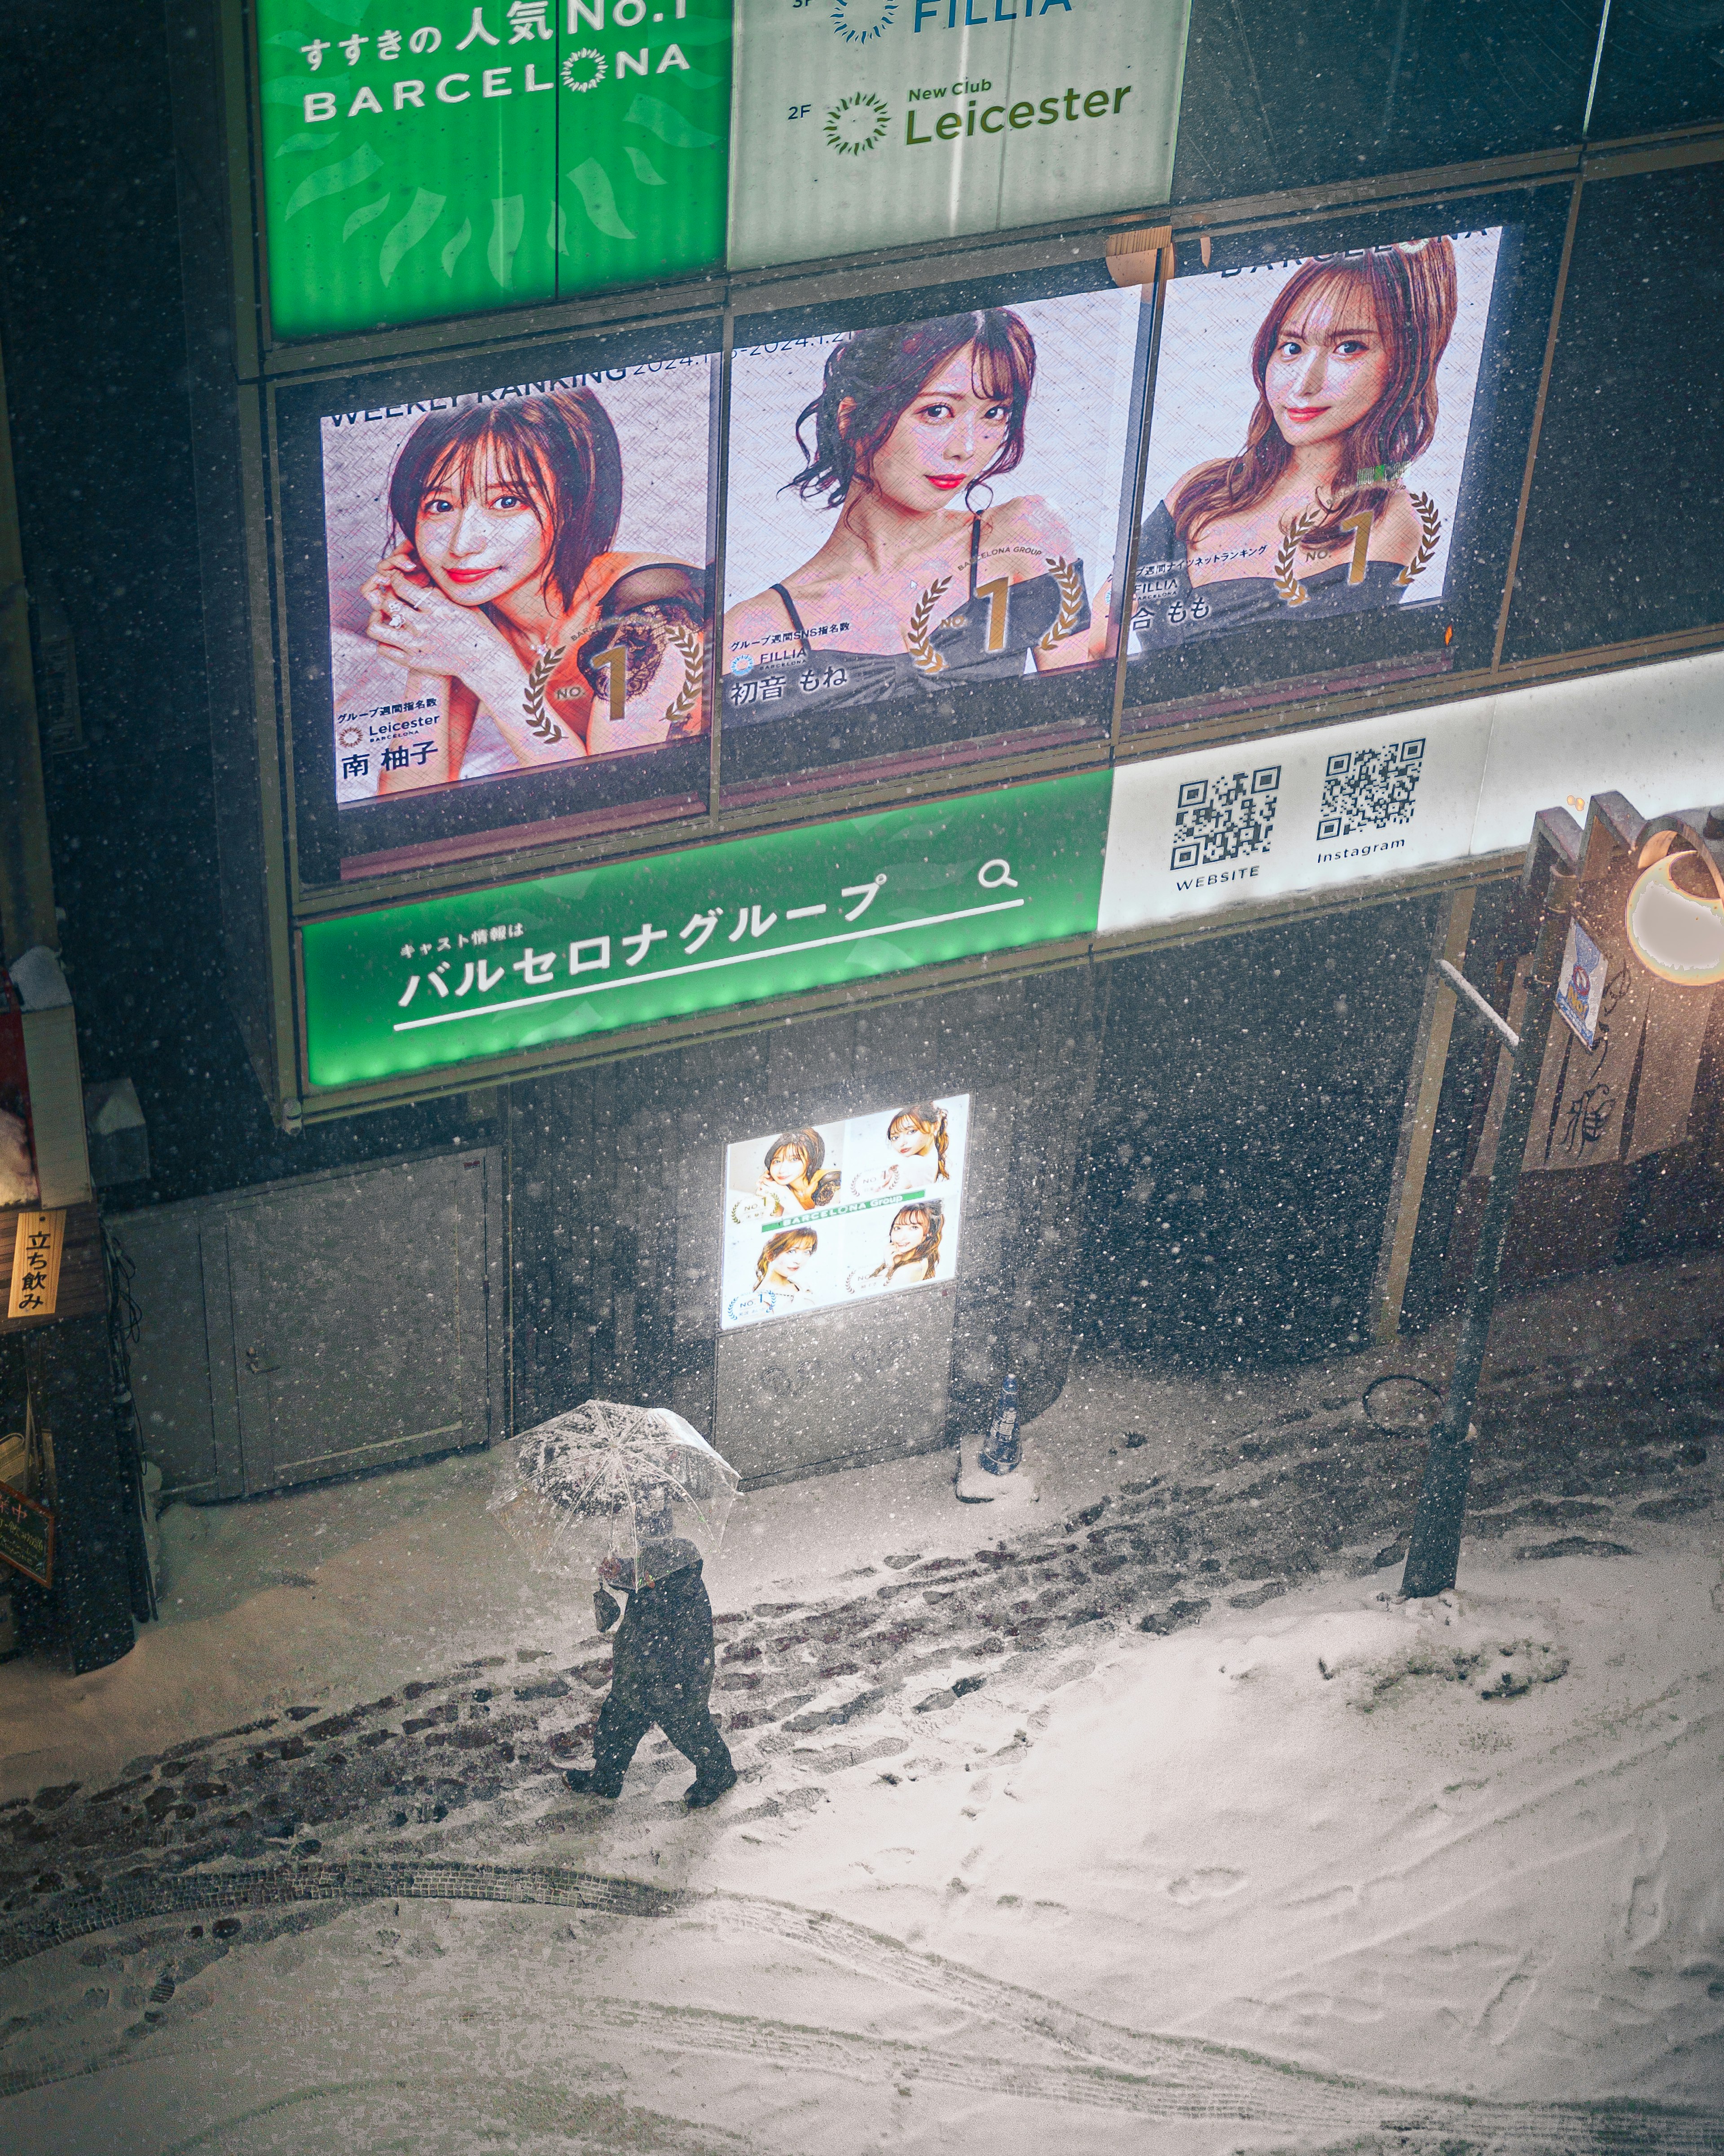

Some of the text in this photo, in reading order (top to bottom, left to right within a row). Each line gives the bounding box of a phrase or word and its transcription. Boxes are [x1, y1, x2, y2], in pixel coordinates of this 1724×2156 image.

[303, 44, 690, 123] BARCELONA
[909, 79, 992, 101] New Club
[788, 104, 811, 120] 2F
[906, 86, 1132, 145] Leicester
[1013, 546, 1042, 556] GROUP
[1108, 544, 1268, 582] プ週間ナイツネットランキング
[1306, 549, 1331, 562] NO.
[1135, 579, 1178, 594] FILLIA
[1168, 597, 1209, 623] もも
[731, 622, 850, 652] グループ週間SNS指名数
[760, 648, 807, 664] FILLIA
[760, 659, 807, 670] BARCELONA
[730, 666, 848, 706] 初音 もね
[338, 697, 438, 724] グループ週間指名数
[369, 715, 440, 736] Leicester
[370, 730, 419, 743] BARCELONA
[342, 741, 438, 779] 南 柚子
[1317, 838, 1405, 863] Instagram
[1177, 865, 1260, 891] WEBSITE
[398, 874, 887, 1007] バルセロナグループ
[400, 922, 524, 959] キャスト情報は
[783, 1203, 867, 1226] BARCELONA
[870, 1195, 903, 1208] Group
[19, 1230, 51, 1309] 立ち飲み
